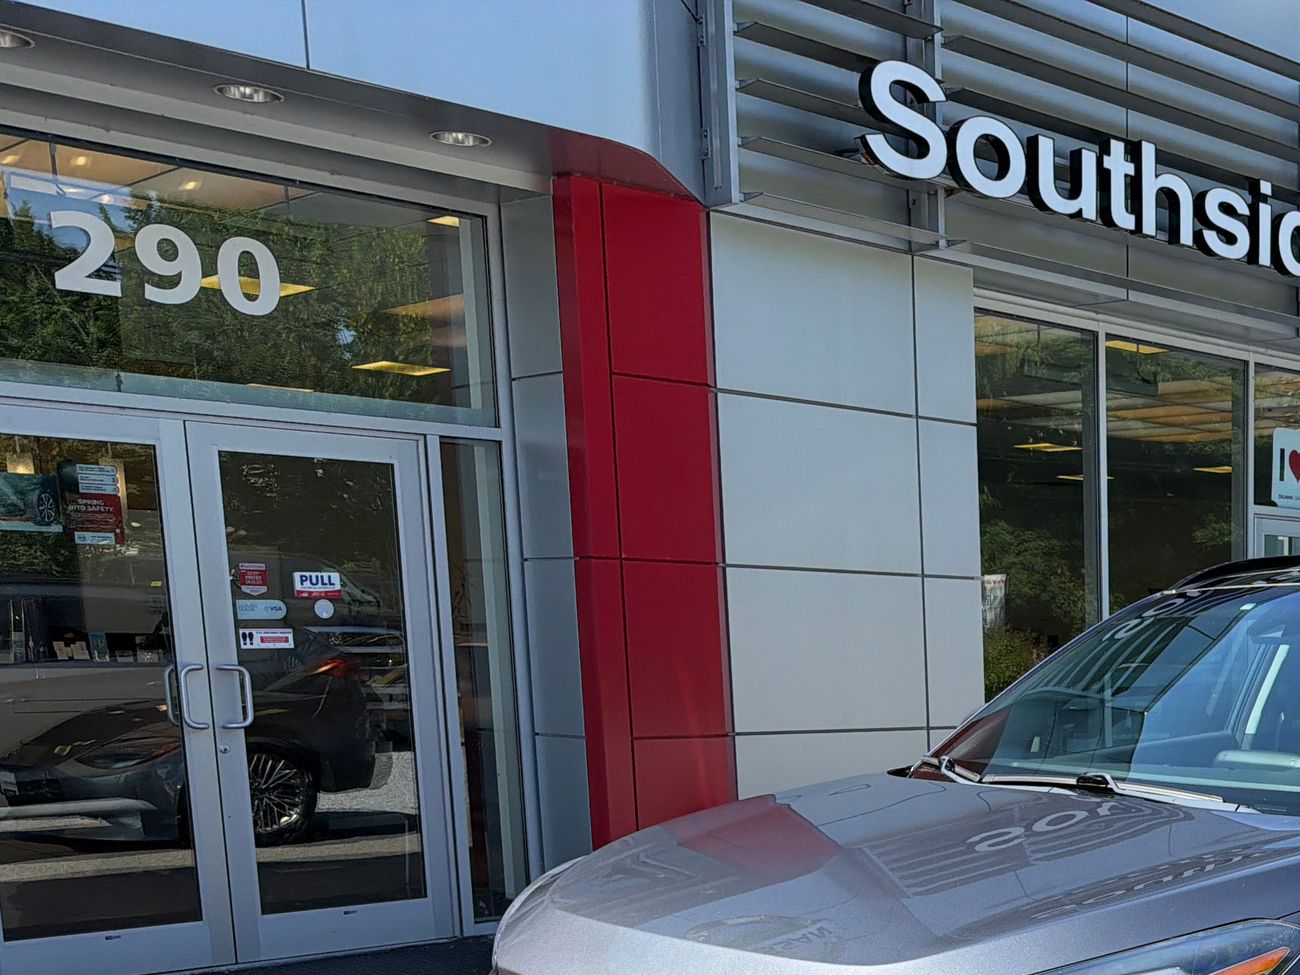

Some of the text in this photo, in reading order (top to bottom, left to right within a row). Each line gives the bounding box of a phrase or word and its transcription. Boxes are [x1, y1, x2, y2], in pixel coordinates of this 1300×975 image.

[50, 209, 281, 316] 290
[1279, 447, 1286, 482] I
[299, 574, 336, 586] PULL
